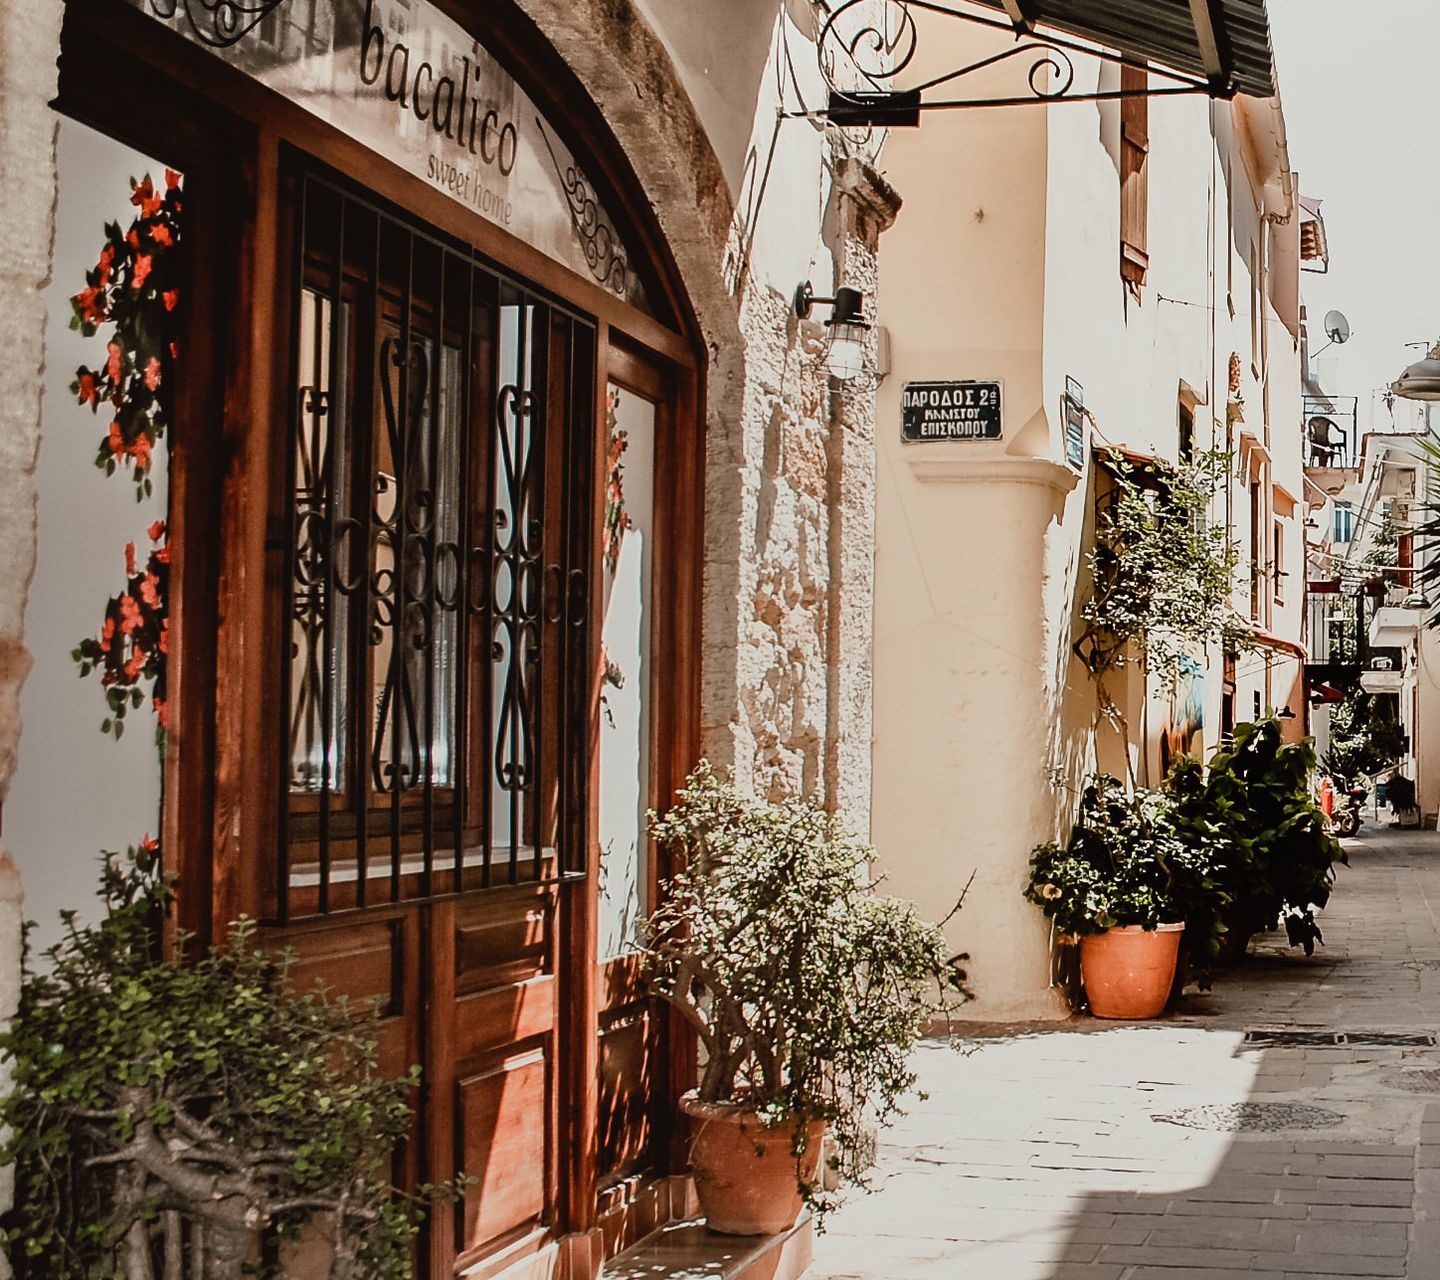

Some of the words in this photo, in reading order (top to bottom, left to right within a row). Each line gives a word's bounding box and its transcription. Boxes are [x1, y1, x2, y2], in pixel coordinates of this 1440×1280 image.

[360, 0, 517, 177] bacalico
[427, 154, 470, 201] sweet
[473, 169, 513, 225] home
[903, 389, 975, 408] ΠΑΡΟΔΟΣ
[921, 420, 989, 436] ΕΠΙΣΚΟΠΟΥ
